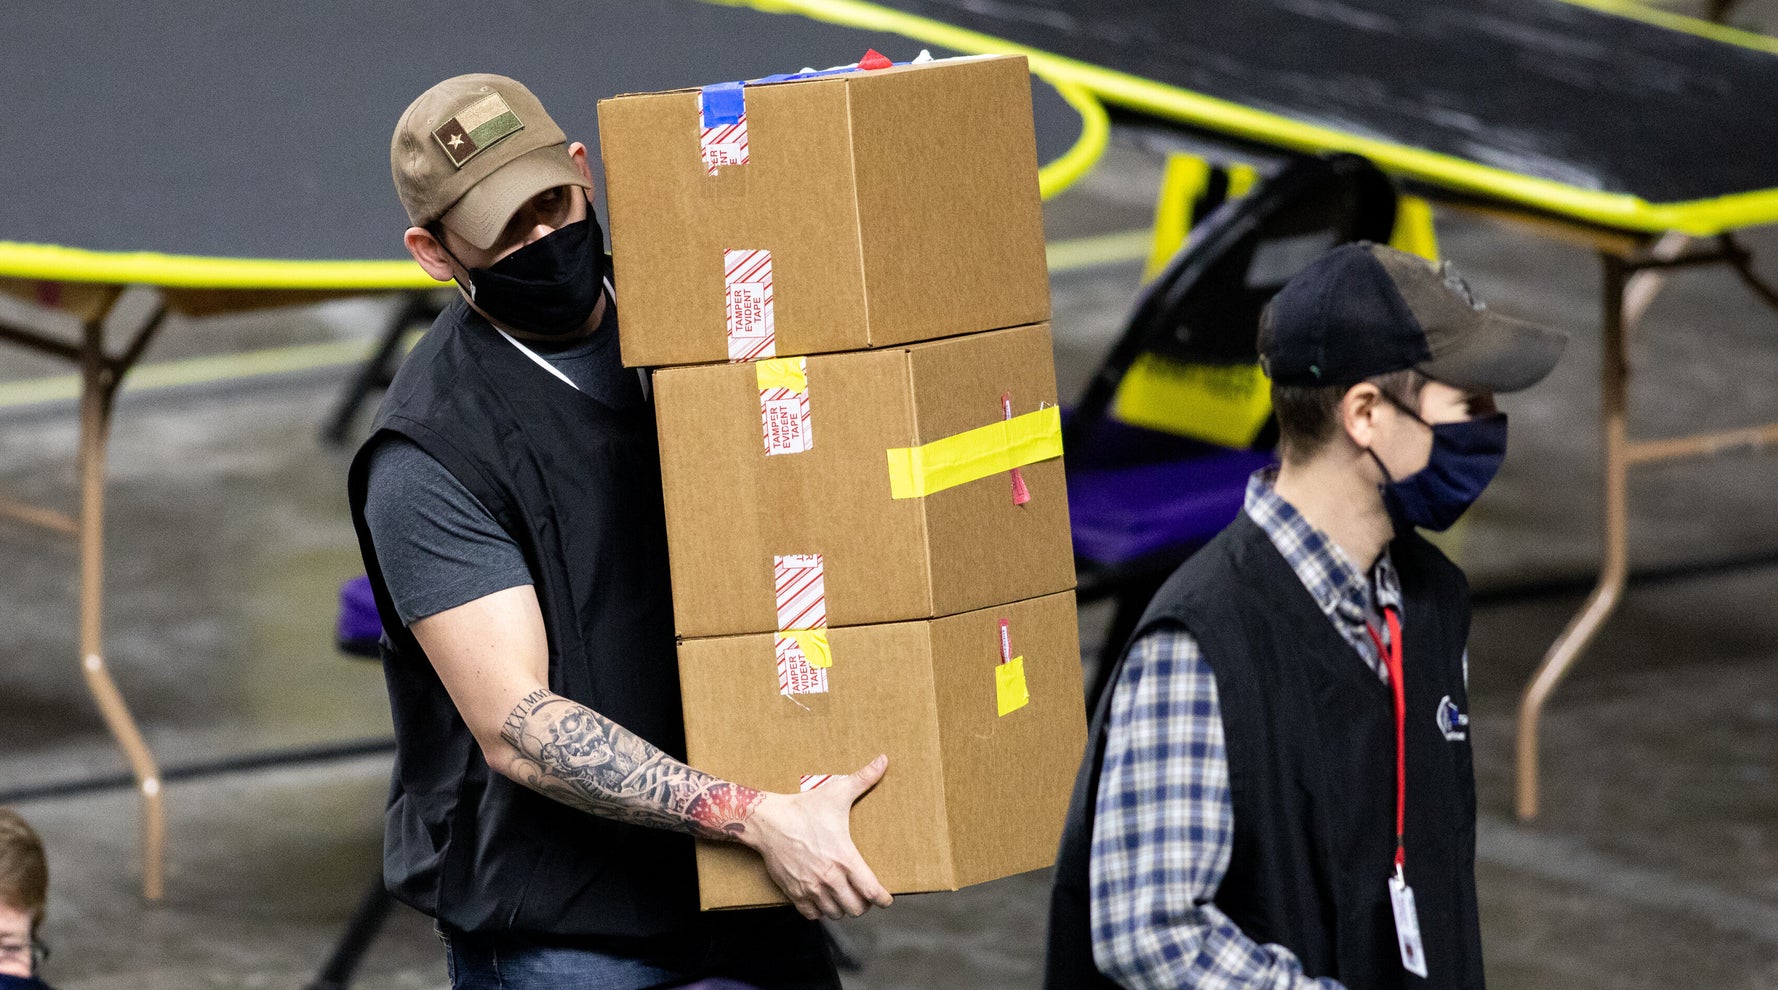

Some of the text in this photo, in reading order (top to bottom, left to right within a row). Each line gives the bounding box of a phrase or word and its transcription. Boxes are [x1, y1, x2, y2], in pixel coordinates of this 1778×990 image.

[734, 290, 743, 331] TAMPER
[744, 289, 752, 332] EVIDENT
[753, 297, 761, 323] TAPE
[770, 407, 780, 448] TAMPER
[780, 405, 790, 448] EVIDENT
[790, 413, 799, 439] TAPE
